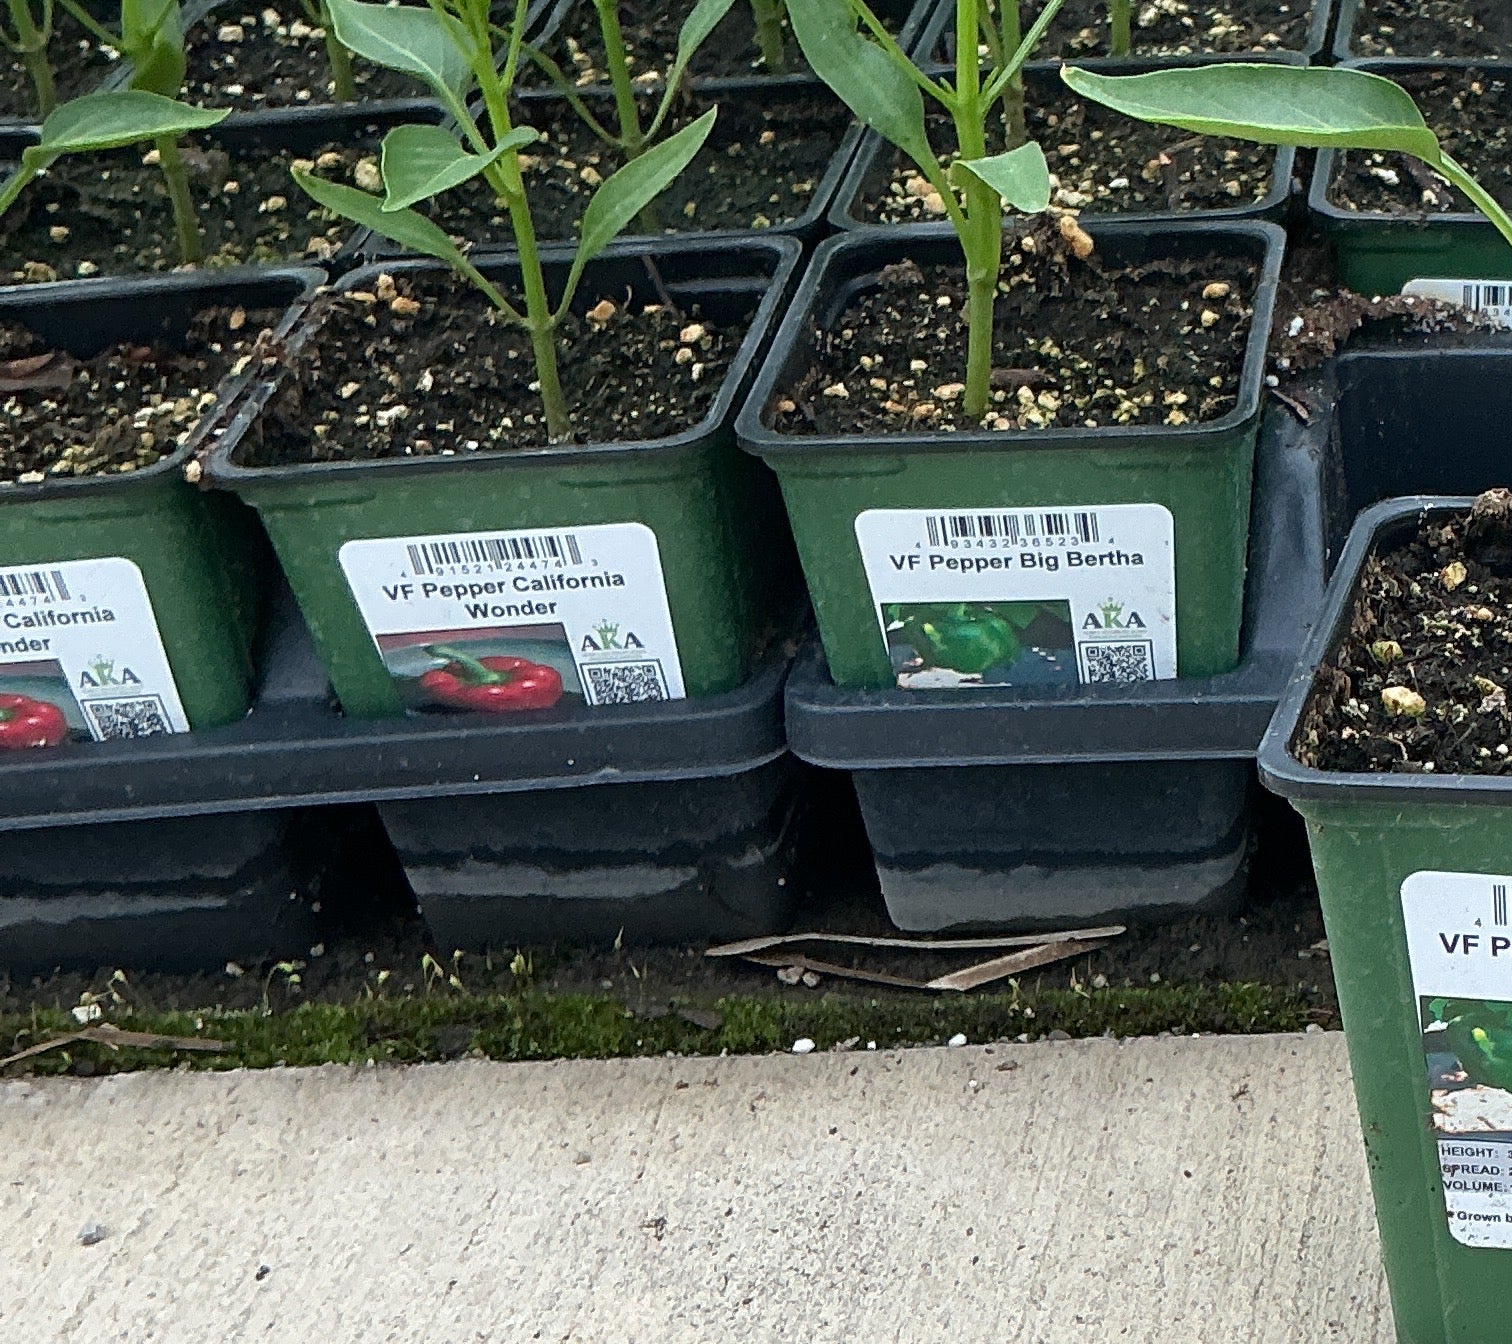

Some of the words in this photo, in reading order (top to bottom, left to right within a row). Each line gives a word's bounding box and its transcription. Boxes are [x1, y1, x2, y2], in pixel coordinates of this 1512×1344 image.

[889, 555, 920, 570] VF
[930, 555, 1013, 573] Pepper
[1020, 552, 1059, 571] Big
[1067, 550, 1144, 567] Bertha
[382, 583, 414, 601] VF
[422, 580, 505, 600] Pepper
[513, 571, 625, 592] California
[3, 606, 116, 629] California
[465, 600, 557, 619] Wonder
[1082, 611, 1145, 630] AKA
[0, 636, 50, 654] nder
[581, 631, 644, 652] AKA
[80, 667, 141, 688] AKA
[1439, 933, 1480, 954] VF
[1441, 1146, 1499, 1159] HEIGHT:
[1443, 1180, 1507, 1193] VOLUME:
[1457, 1210, 1501, 1223] Grown
